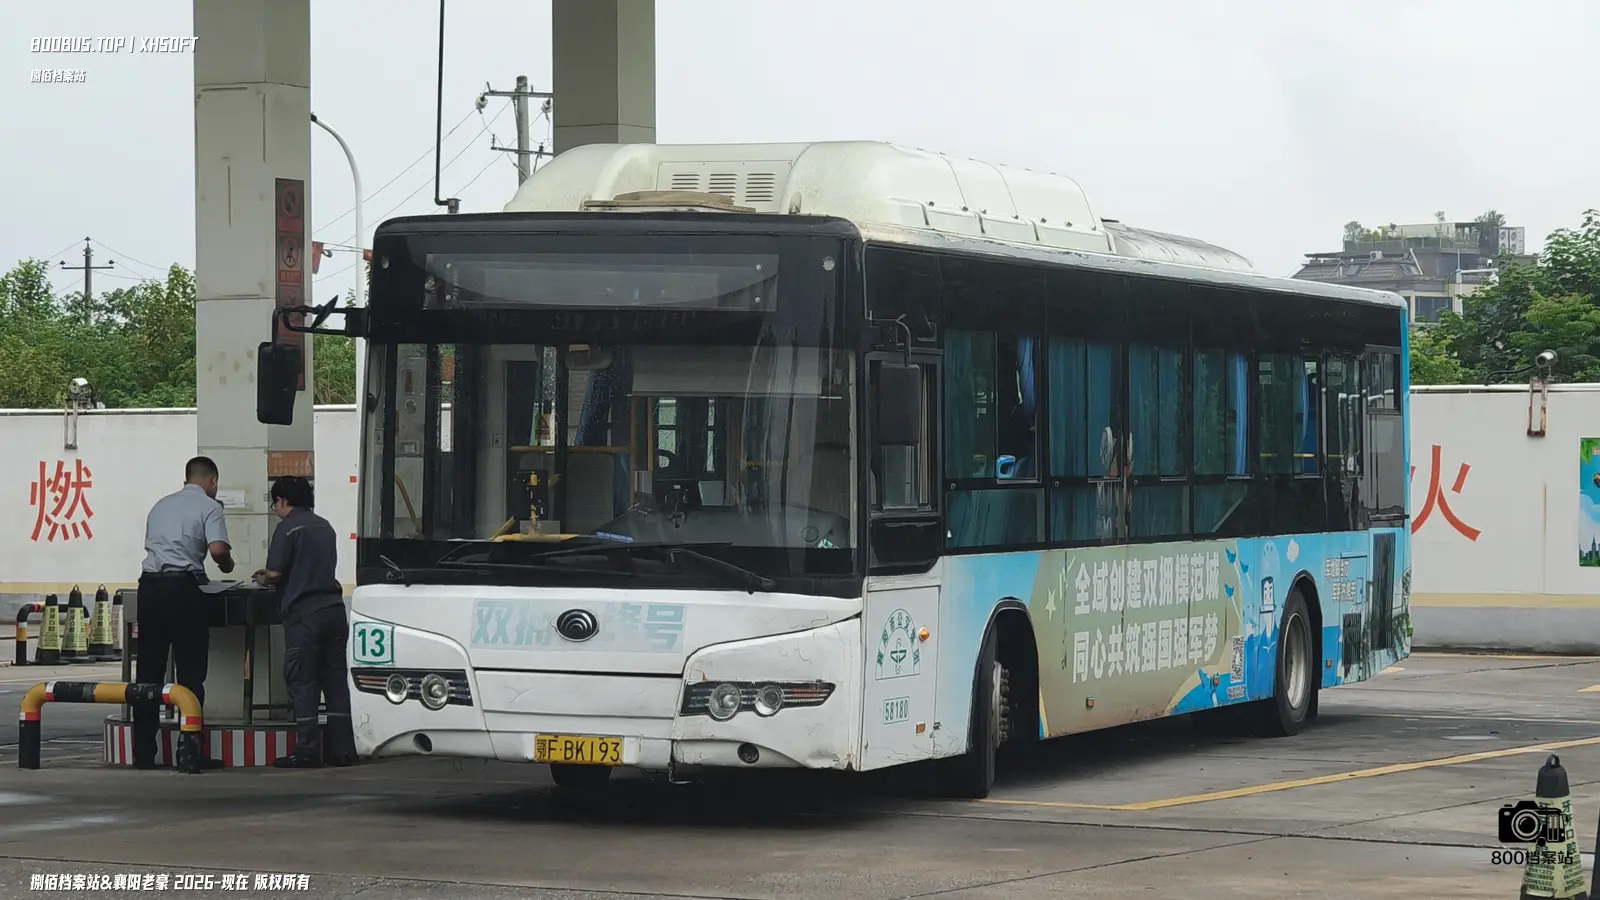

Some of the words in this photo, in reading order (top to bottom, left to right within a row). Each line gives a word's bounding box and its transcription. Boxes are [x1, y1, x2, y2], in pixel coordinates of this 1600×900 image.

[30, 458, 94, 543] 燃
[1410, 445, 1482, 542] 火
[1075, 551, 1219, 615] 全域创建双拥模范城
[358, 628, 385, 657] 13
[1073, 612, 1218, 683] 同心共筑强国强军梦
[885, 702, 908, 722] 58180
